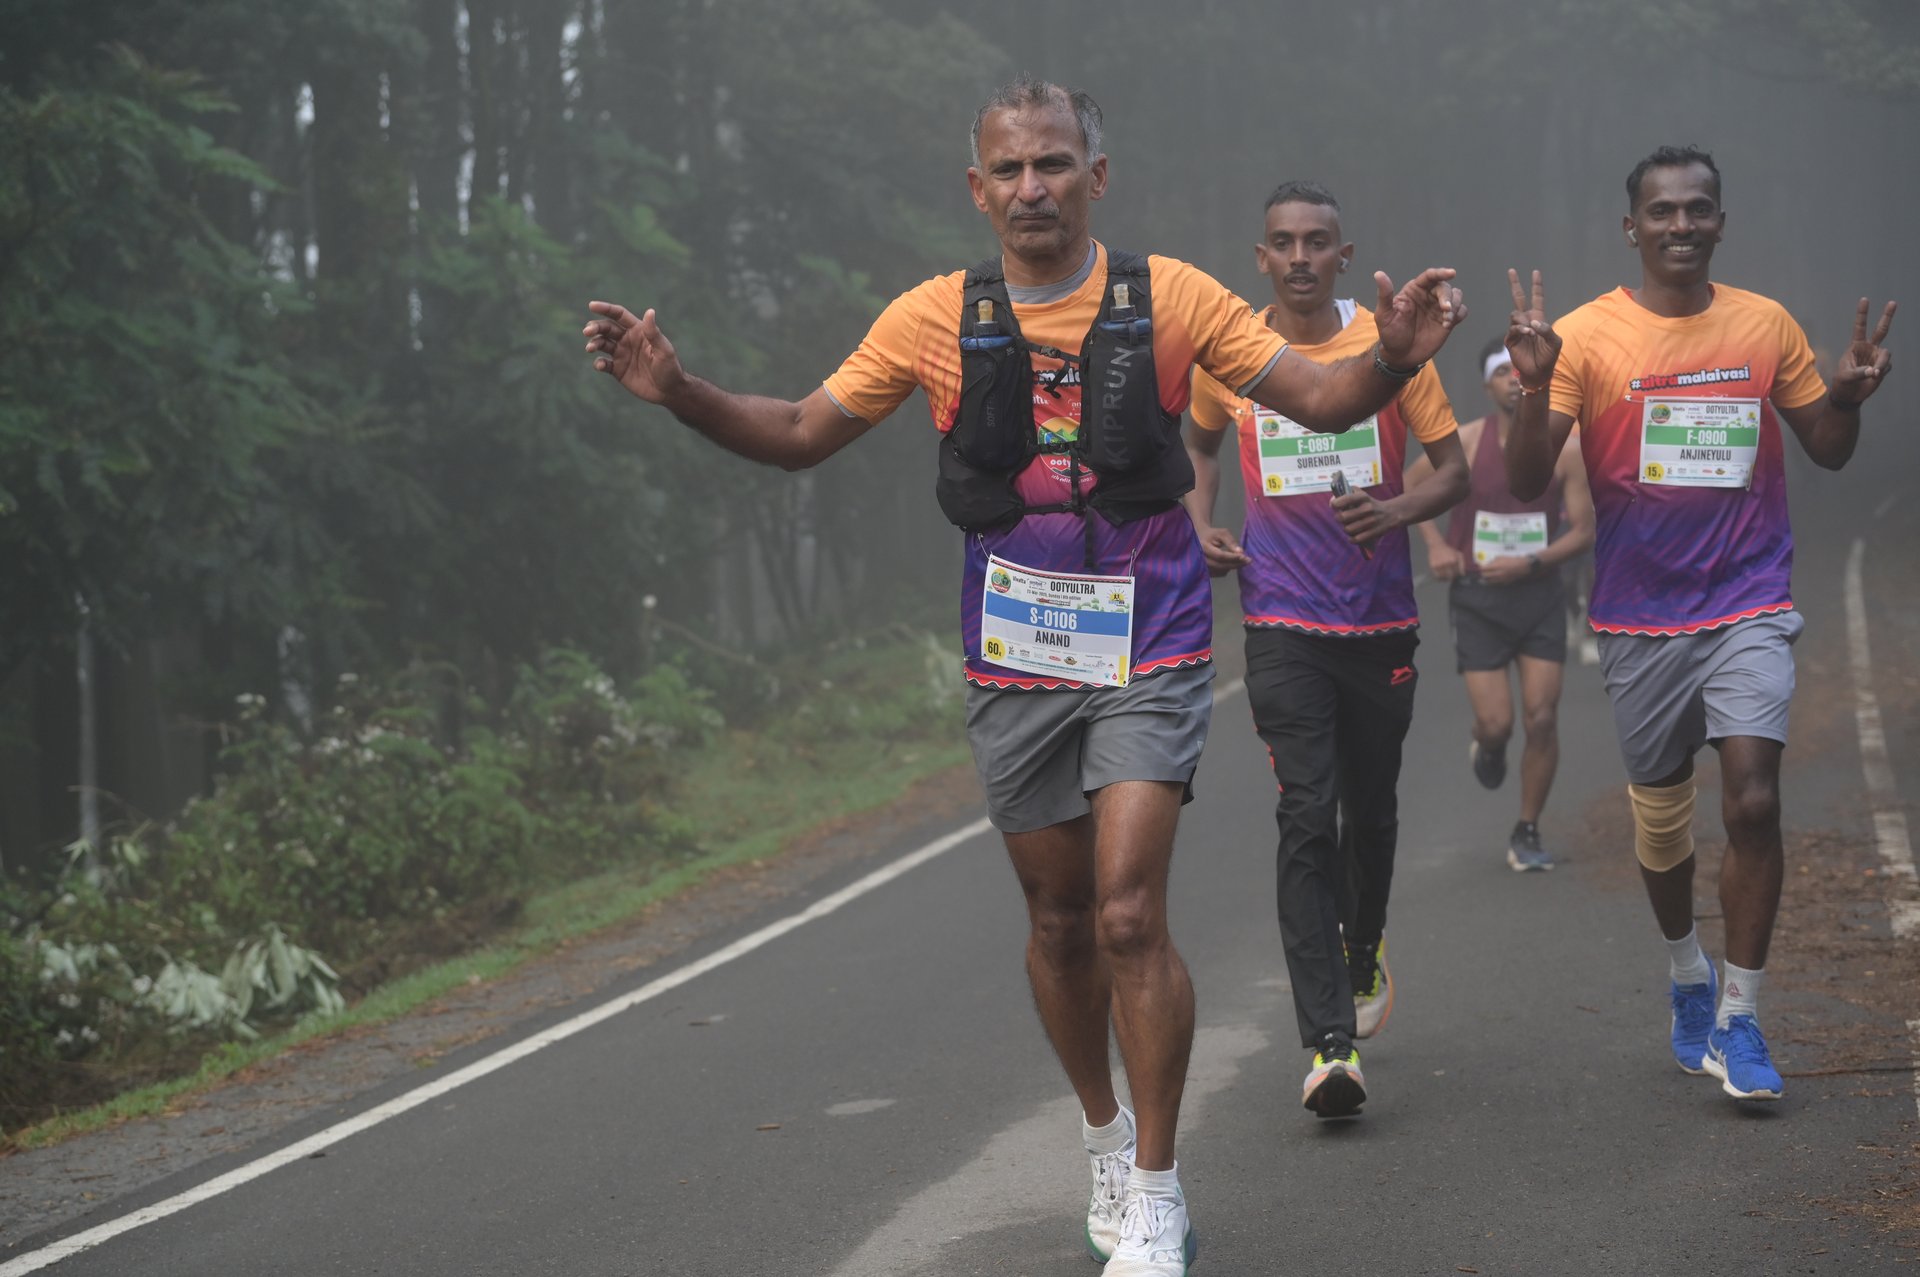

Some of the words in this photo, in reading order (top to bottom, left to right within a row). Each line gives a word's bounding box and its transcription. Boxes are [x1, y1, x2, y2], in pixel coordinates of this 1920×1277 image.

[1630, 366, 1750, 390] #ultramalaivasi
[1103, 346, 1134, 466] KIPRUN
[1705, 405, 1739, 414] OOTYULTRA
[1297, 436, 1337, 453] F-0897
[1686, 429, 1727, 445] F-0900
[1297, 454, 1341, 469] SURENDRA
[1680, 448, 1731, 460] ANJINEYULU
[1050, 581, 1096, 595] OOTYULTRA
[1029, 606, 1078, 631] S-0106
[1035, 630, 1071, 648] ANAND
